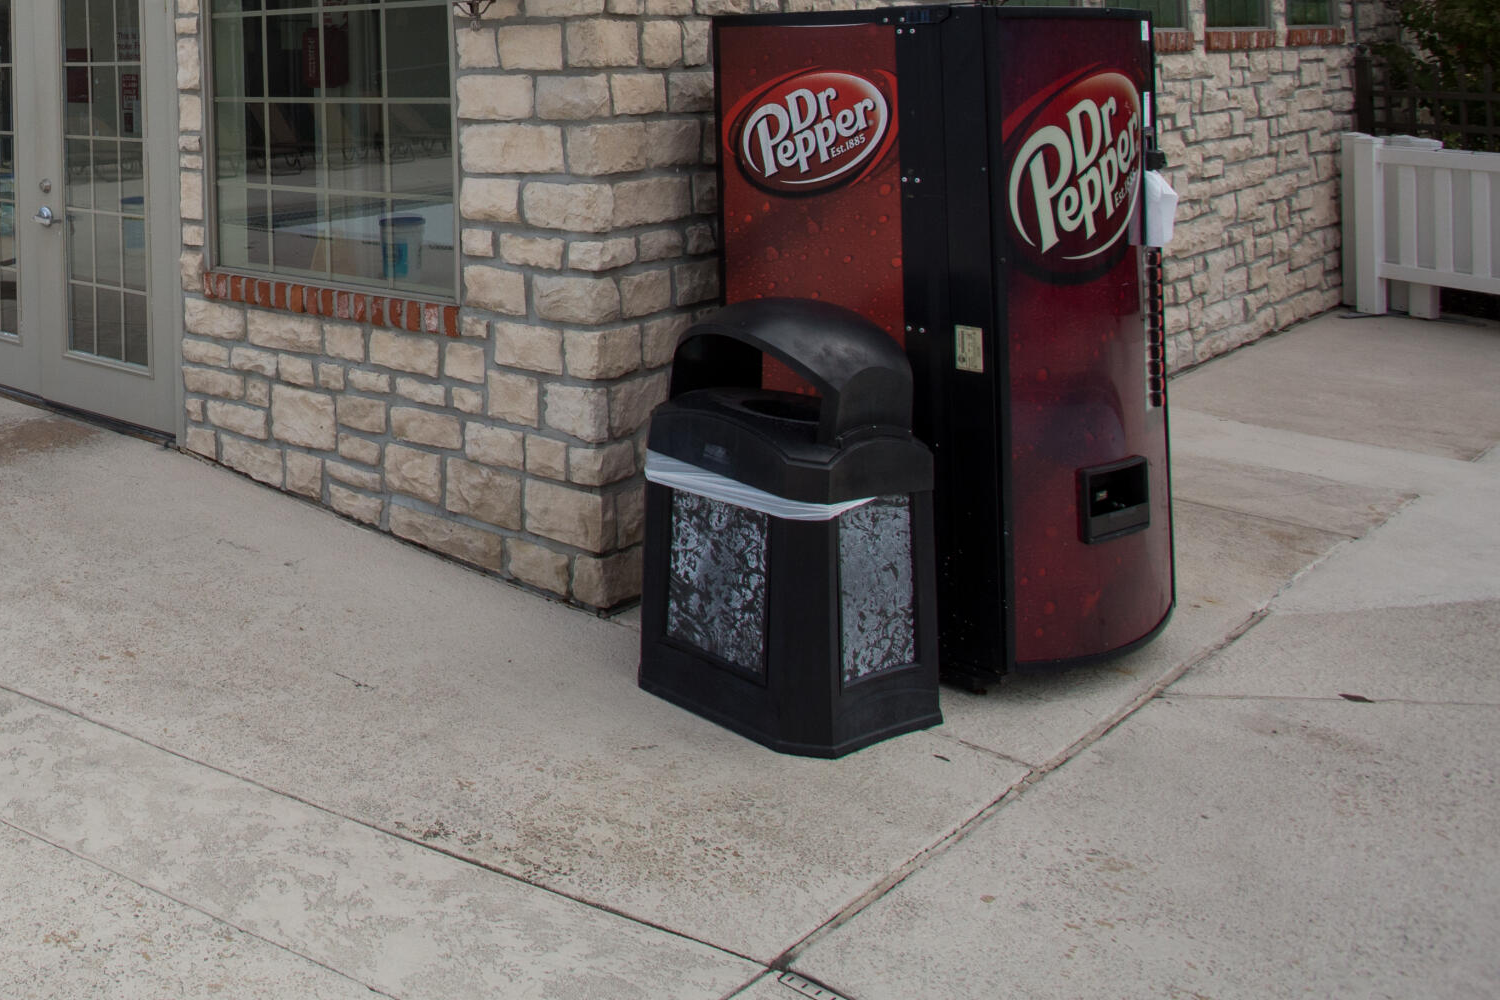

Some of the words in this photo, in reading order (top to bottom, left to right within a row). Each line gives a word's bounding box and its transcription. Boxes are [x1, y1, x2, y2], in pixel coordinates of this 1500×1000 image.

[743, 98, 875, 178] Pepper
[785, 87, 837, 134] Dr
[1066, 96, 1117, 176] Dr
[1009, 112, 1138, 254] Pepper
